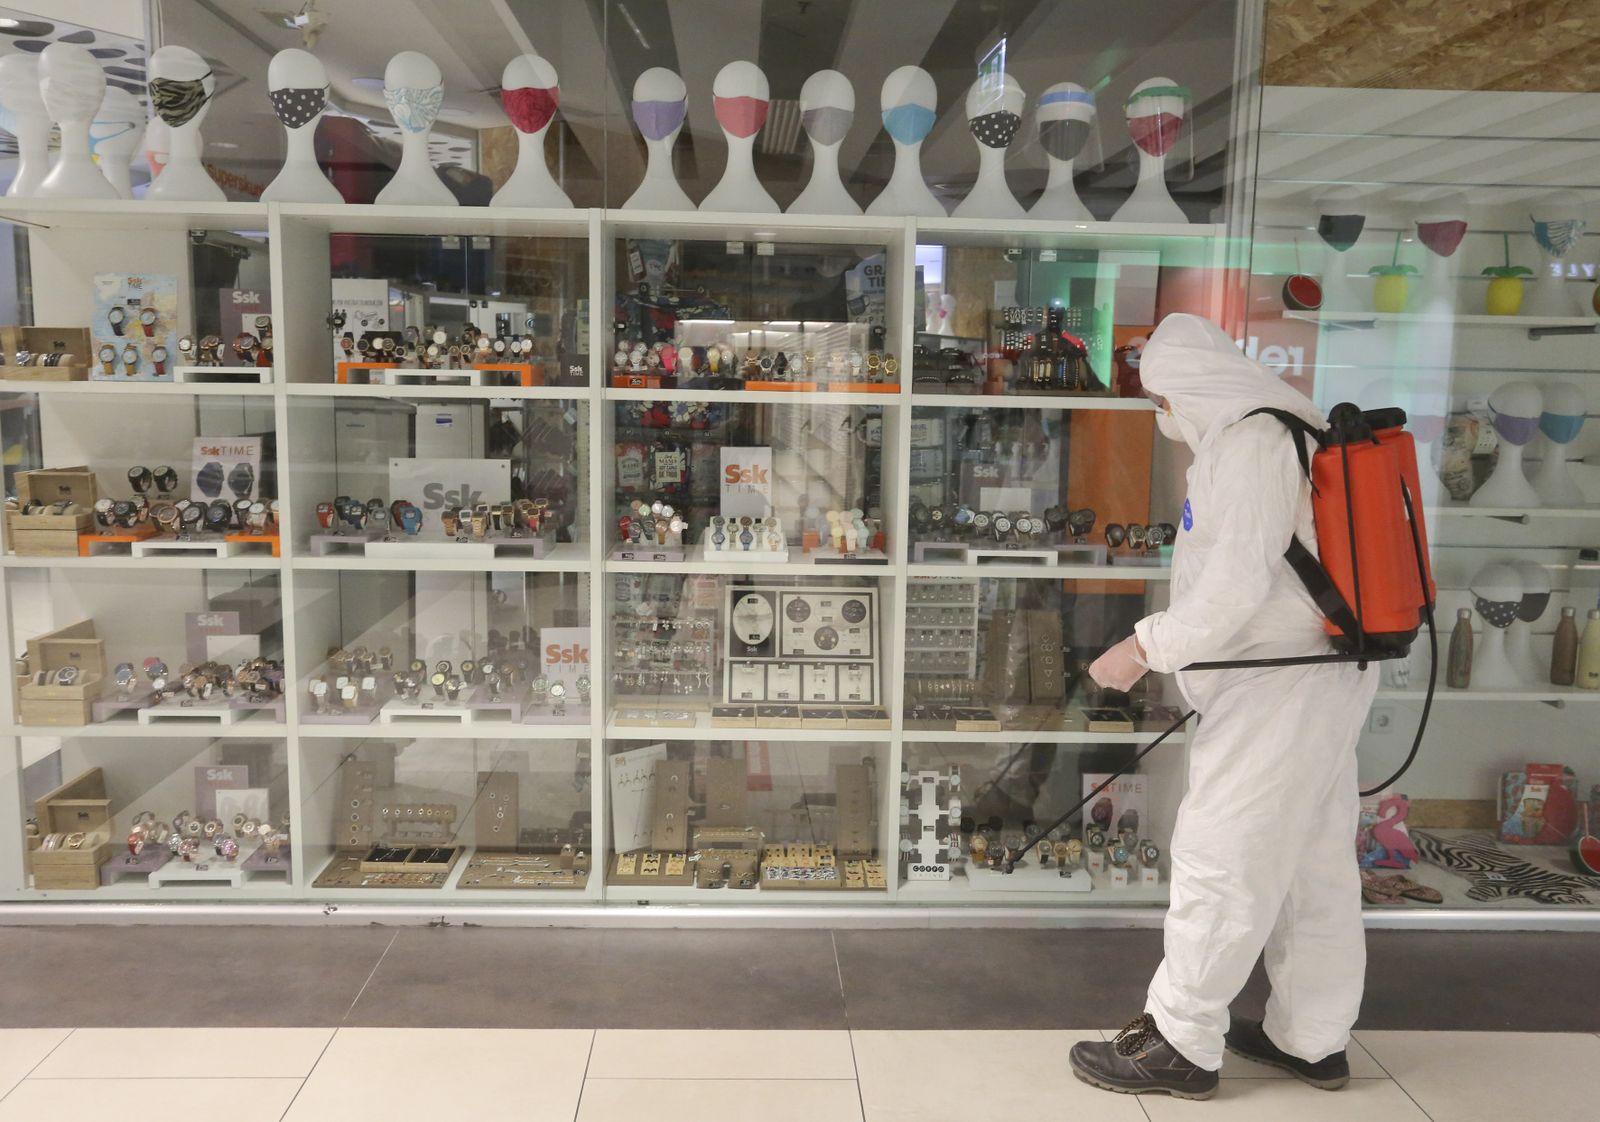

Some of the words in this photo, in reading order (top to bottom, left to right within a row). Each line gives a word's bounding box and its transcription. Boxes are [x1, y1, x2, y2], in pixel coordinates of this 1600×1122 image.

[232, 290, 260, 304] Ssk
[725, 463, 769, 485] Ssk
[973, 465, 999, 478] Ssk
[423, 482, 482, 510] Ssk
[198, 614, 225, 627] Ssk
[545, 643, 589, 665] Ssk
[207, 768, 233, 781] Ssk
